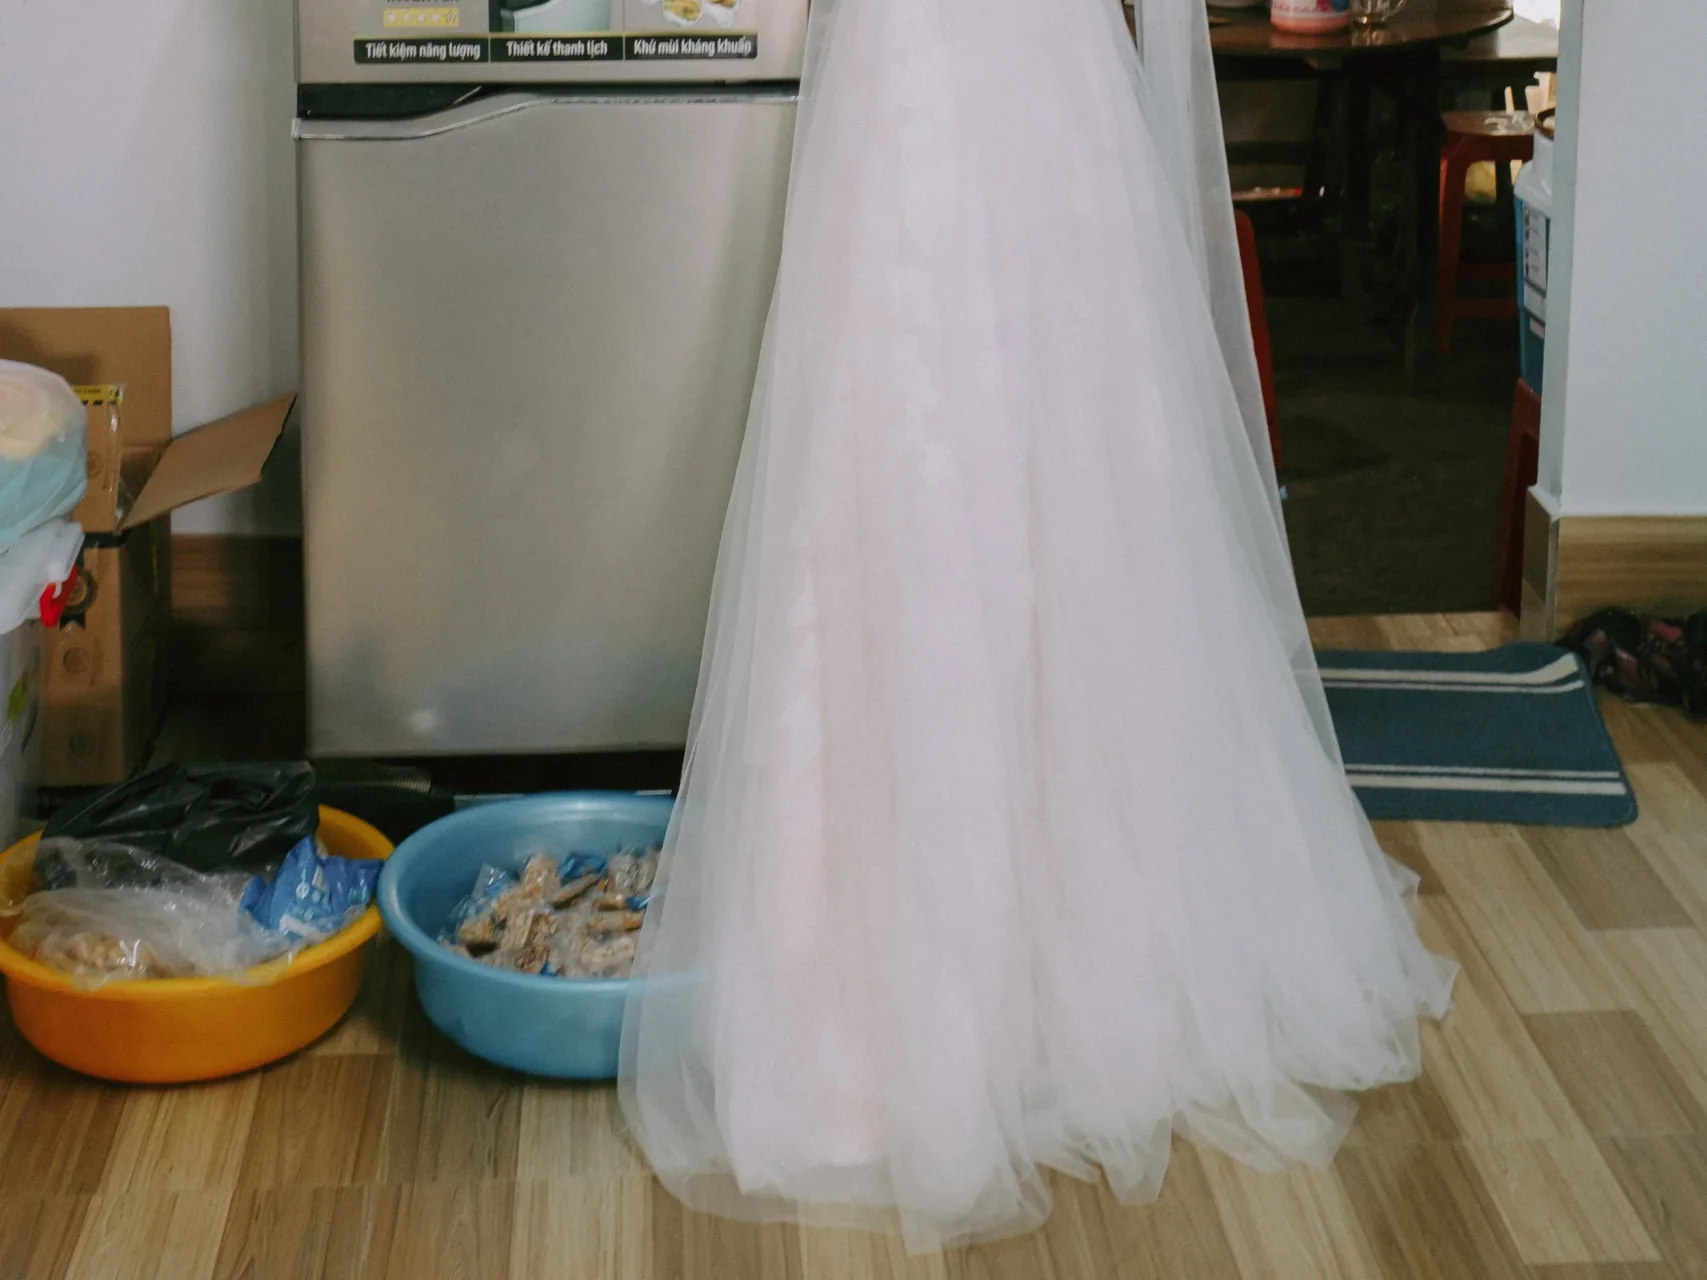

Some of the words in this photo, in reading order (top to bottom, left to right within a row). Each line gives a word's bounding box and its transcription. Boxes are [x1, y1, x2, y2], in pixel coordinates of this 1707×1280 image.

[365, 41, 388, 58] Tiết
[389, 42, 417, 61] kiệm
[419, 42, 447, 61] năng
[449, 41, 481, 60] lượng
[506, 39, 535, 56] Thiết
[536, 39, 553, 56] kế
[553, 40, 585, 56] thanh
[587, 39, 608, 58] lịch
[681, 38, 716, 57] kháng
